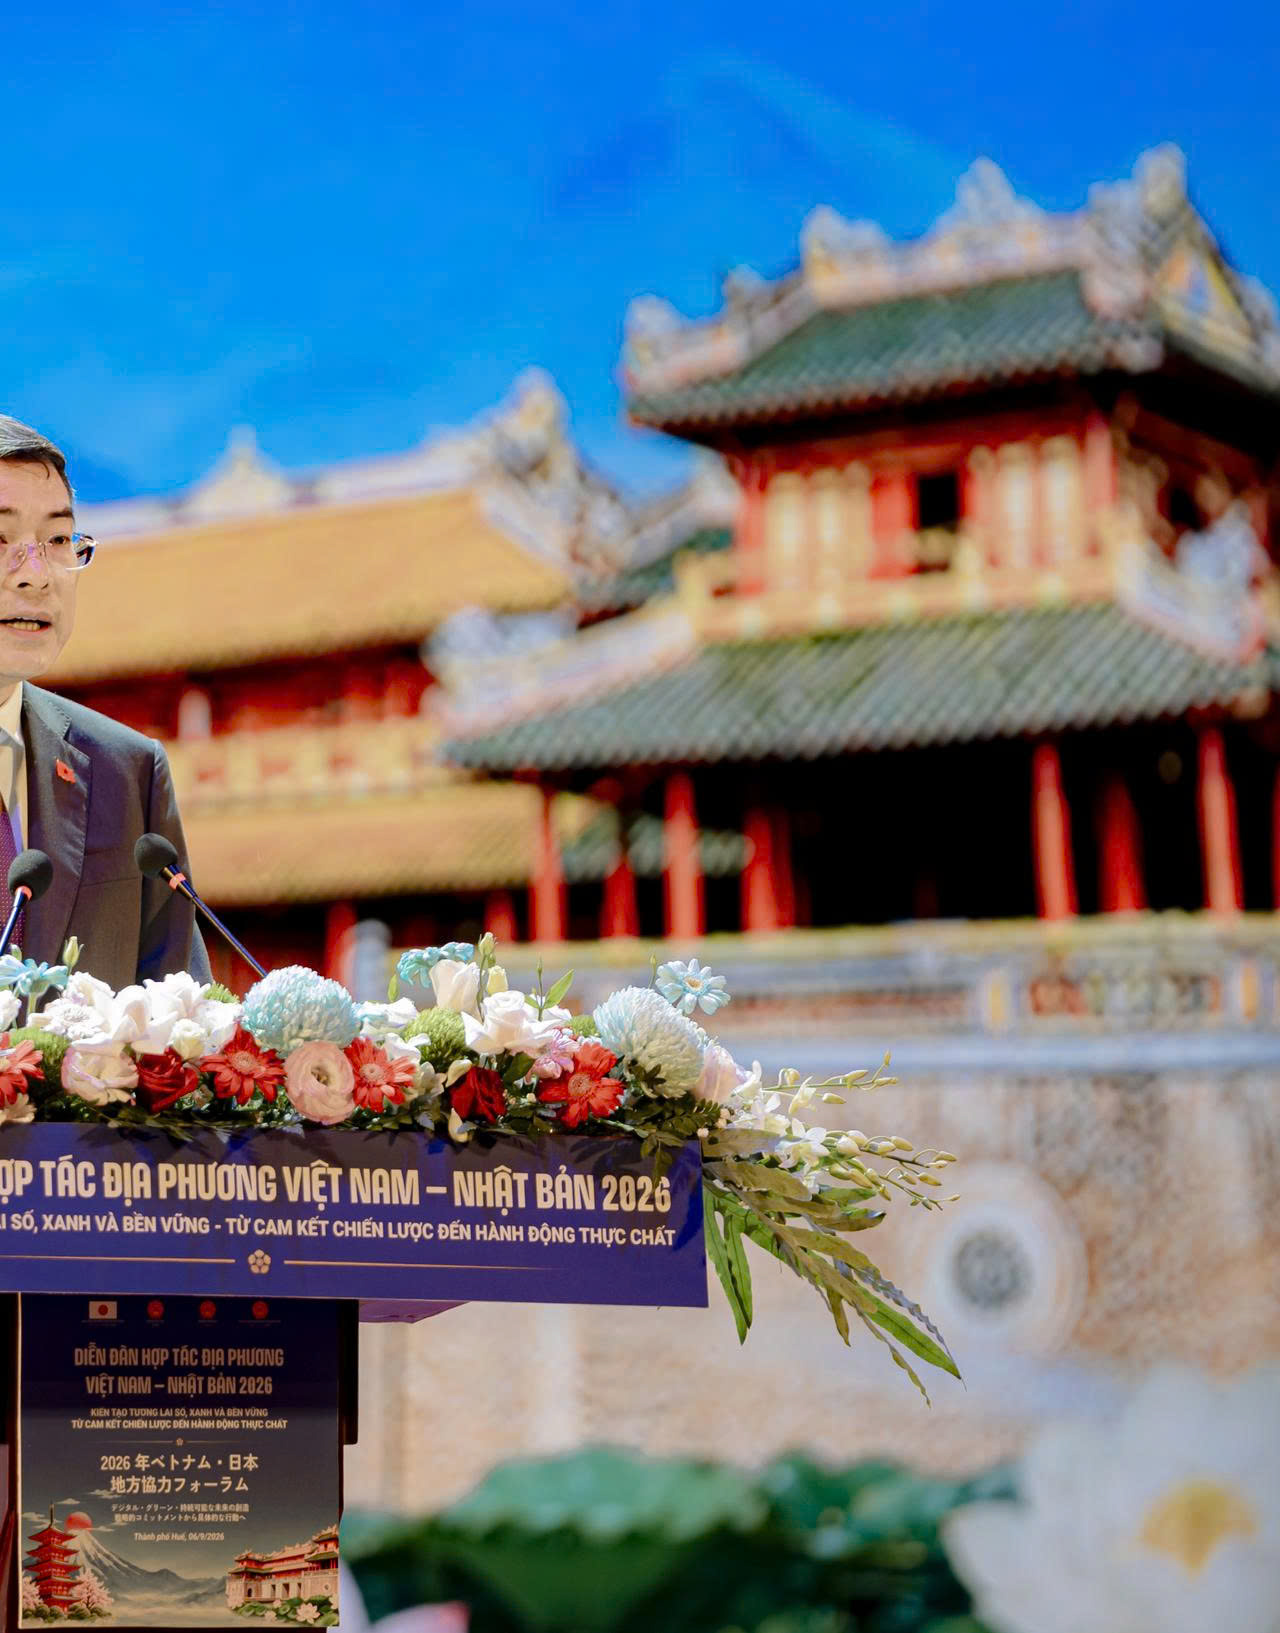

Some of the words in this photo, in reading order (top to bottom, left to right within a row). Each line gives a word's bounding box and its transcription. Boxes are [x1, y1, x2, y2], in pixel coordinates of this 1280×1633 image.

[40, 1155, 96, 1197] TÁC
[103, 1163, 151, 1207] ĐỊA
[158, 1162, 277, 1203] PHƯƠNG
[281, 1159, 343, 1210] VIỆT
[350, 1167, 420, 1205] NAM
[453, 1165, 528, 1215] NHẬT
[537, 1165, 596, 1210] BẢN
[602, 1175, 671, 1213] 2026
[11, 1209, 39, 1233] SỐ,
[42, 1214, 91, 1231] XANH
[95, 1211, 119, 1231] VÀ
[123, 1211, 156, 1232] BỀN
[160, 1214, 210, 1233] VỮNG
[226, 1217, 249, 1236] TỪ
[254, 1218, 292, 1236] CAM
[297, 1215, 329, 1236] KẾT
[333, 1216, 384, 1238] CHIẾN
[388, 1222, 433, 1243] LƯỢC
[438, 1218, 471, 1240] ĐẾN
[475, 1220, 524, 1242] HÀNH
[528, 1222, 575, 1246] ĐỘNG
[579, 1227, 626, 1247] THỰC
[630, 1223, 675, 1246] CHẤT
[75, 1342, 106, 1366] DIỄN
[110, 1346, 138, 1366] ĐÀN
[142, 1349, 169, 1370] HỢP
[172, 1346, 199, 1366] TÁC
[202, 1349, 224, 1370] ĐỊA
[228, 1348, 284, 1367] PHƯƠNG
[85, 1373, 114, 1397] VIỆT
[118, 1377, 151, 1394] NAM
[168, 1373, 204, 1397] NHẬT
[207, 1372, 235, 1394] BẢN
[239, 1376, 273, 1394] 2026
[101, 1455, 131, 1470] 2026
[135, 1454, 258, 1471] 年ベトナム・日本
[110, 1476, 249, 1493] 地方協力フォーラム
[188, 1532, 224, 1540] 06/9/2026
